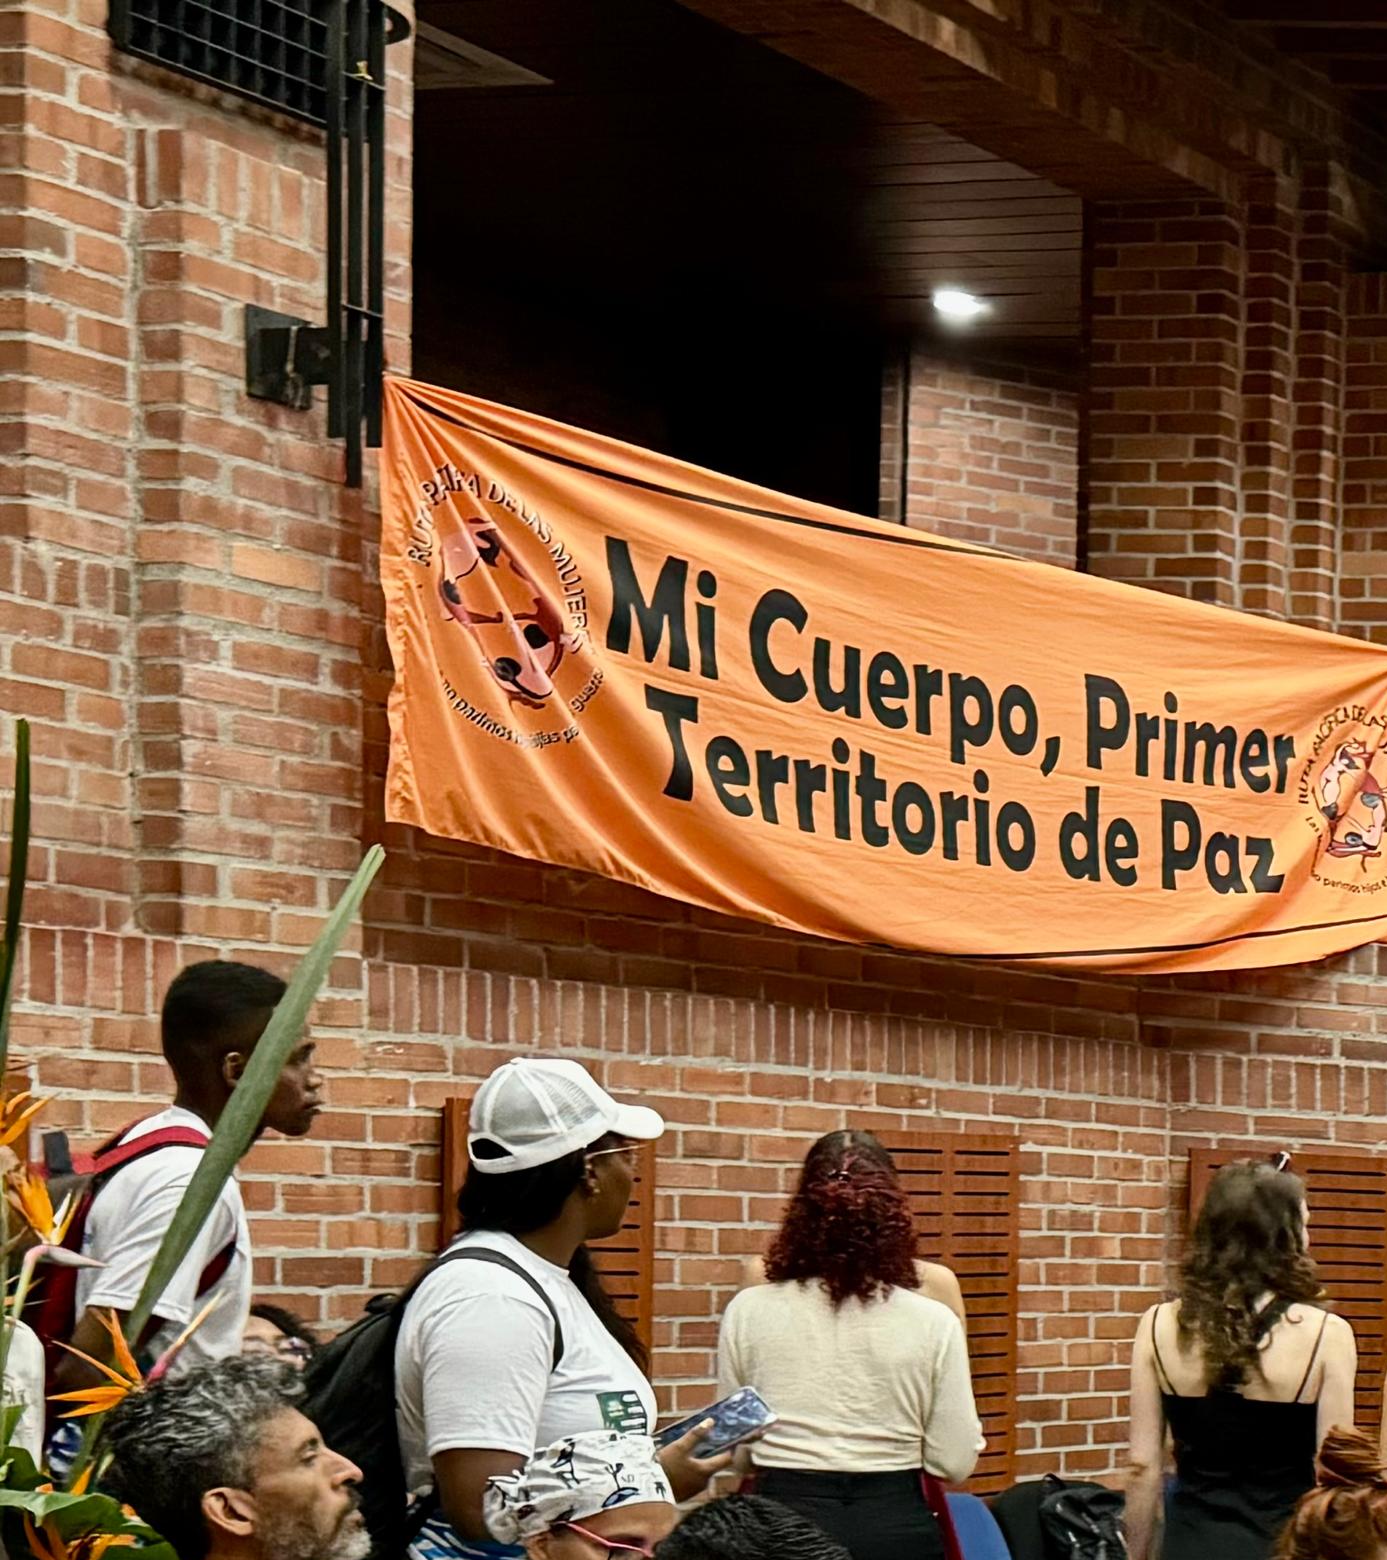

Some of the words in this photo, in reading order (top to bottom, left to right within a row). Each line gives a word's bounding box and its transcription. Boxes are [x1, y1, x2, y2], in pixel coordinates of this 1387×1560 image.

[604, 536, 720, 681] Mi
[748, 588, 1062, 778] Cuerpo,
[1084, 673, 1297, 795] Primer
[644, 683, 1038, 873] Territorio
[1058, 787, 1139, 888] de
[1161, 799, 1285, 895] Paz
